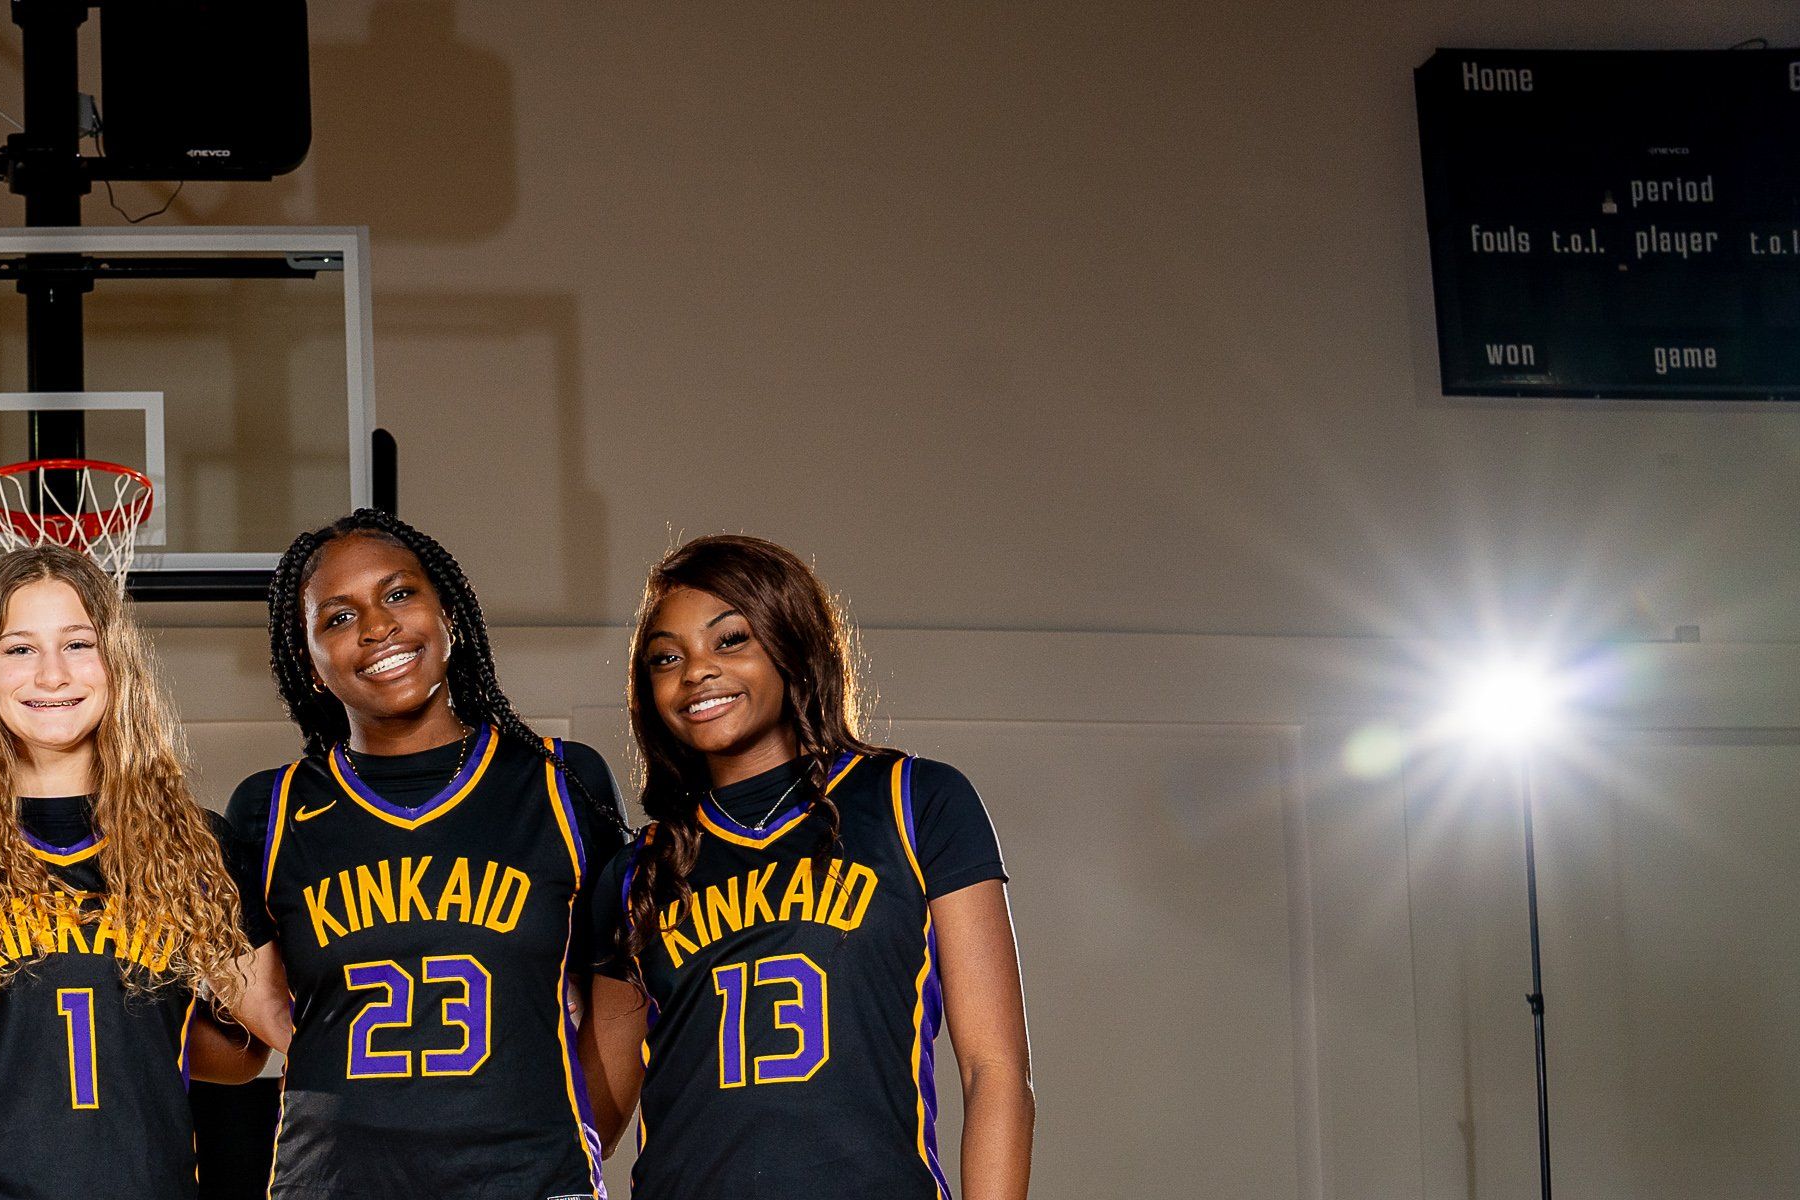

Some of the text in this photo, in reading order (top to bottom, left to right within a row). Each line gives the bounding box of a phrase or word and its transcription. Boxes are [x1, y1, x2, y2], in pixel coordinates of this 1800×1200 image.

[1462, 61, 1534, 91] Home
[1631, 175, 1714, 207] period
[1471, 224, 1531, 253] fouls
[1552, 228, 1605, 254] t.o.l.
[1635, 226, 1718, 259] player
[1486, 344, 1717, 375] won game
[303, 856, 531, 948] KINKAID
[659, 857, 878, 968] KINKAID
[57, 988, 99, 1109] 1
[344, 954, 491, 1079] 23
[712, 953, 829, 1089] 13
